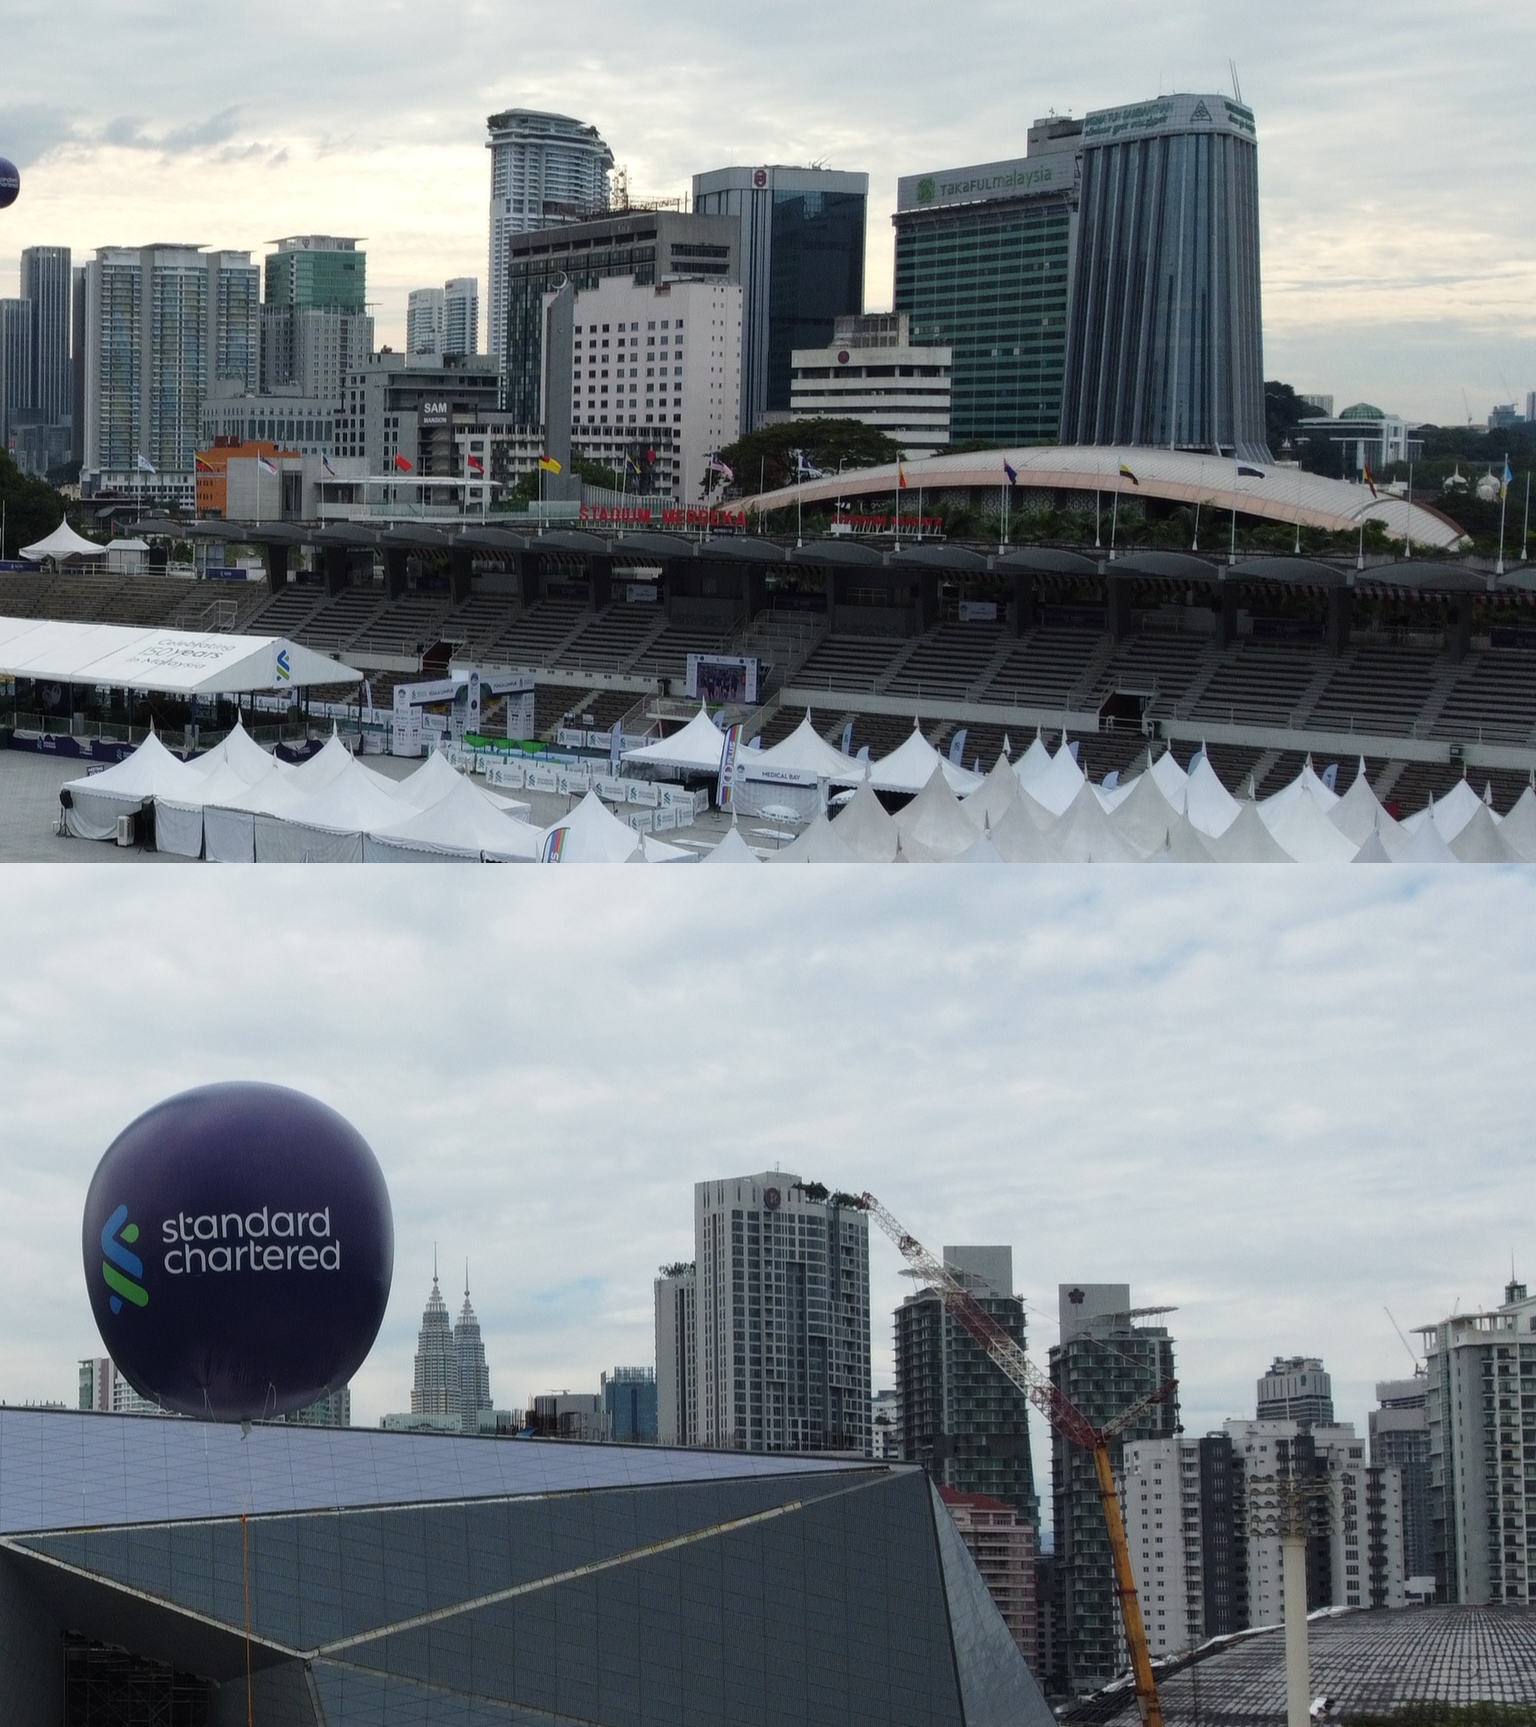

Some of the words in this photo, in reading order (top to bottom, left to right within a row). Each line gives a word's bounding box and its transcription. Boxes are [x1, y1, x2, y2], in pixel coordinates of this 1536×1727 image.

[423, 402, 447, 413] SAM
[579, 504, 650, 524] STADIUM
[663, 504, 747, 526] MERDEKA
[158, 638, 236, 652] Celebrating
[176, 648, 223, 661] years
[141, 657, 207, 670] Malaysia
[762, 771, 786, 780] MEDICAL
[162, 1206, 331, 1243] standard
[164, 1239, 341, 1272] chartered
